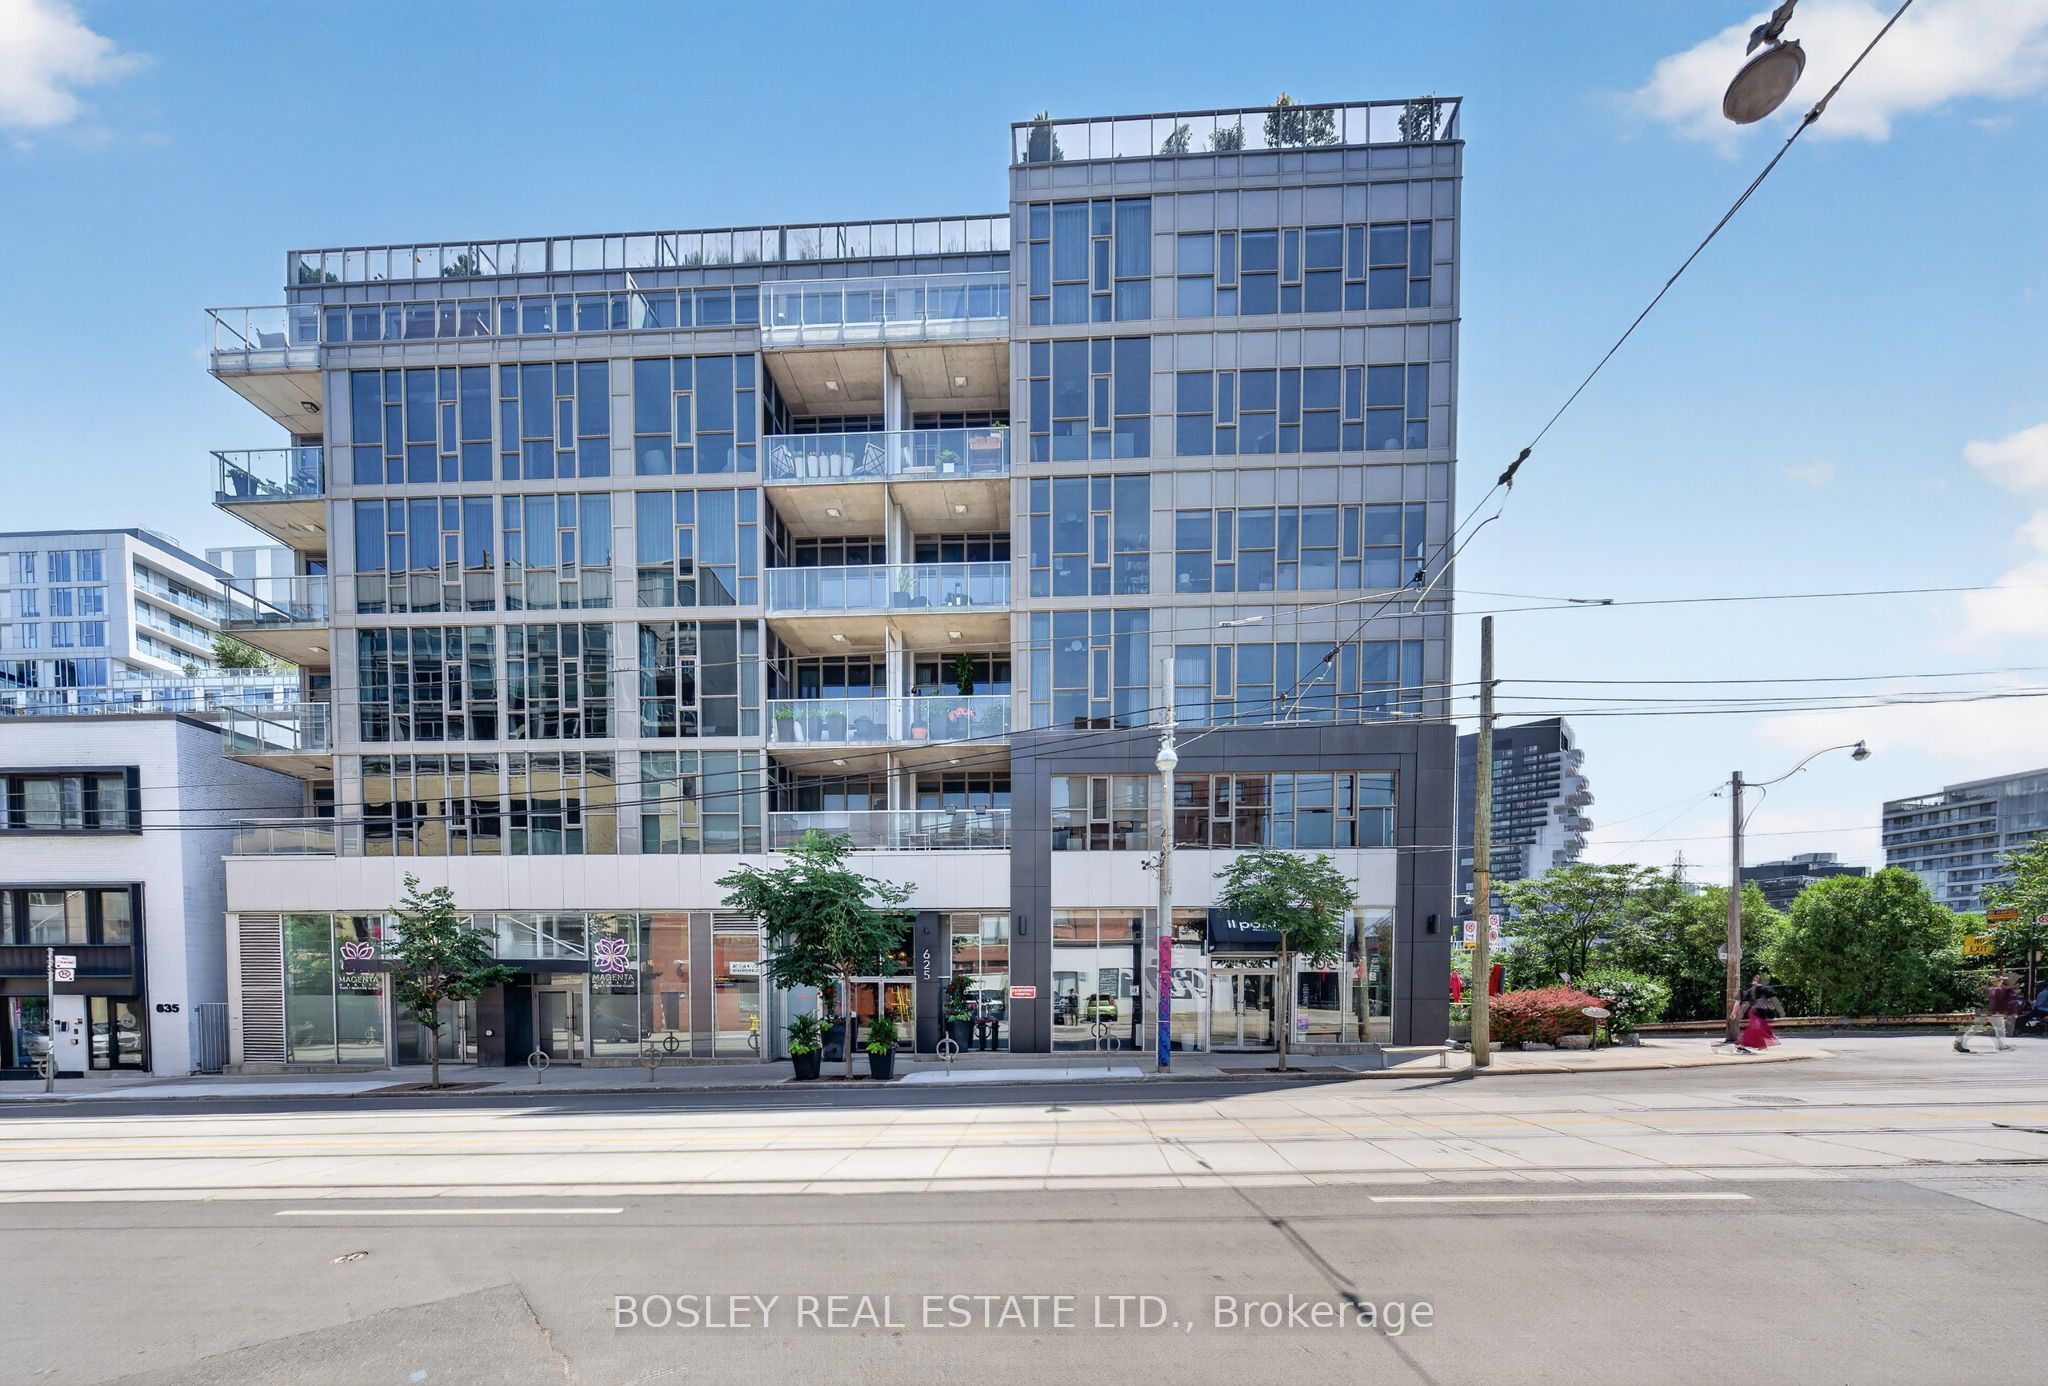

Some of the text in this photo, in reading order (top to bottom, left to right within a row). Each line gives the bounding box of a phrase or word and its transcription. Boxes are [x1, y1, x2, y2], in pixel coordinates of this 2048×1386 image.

[1969, 945, 1988, 953] EXIT
[922, 949, 931, 980] 625
[592, 973, 634, 981] MAGENTA
